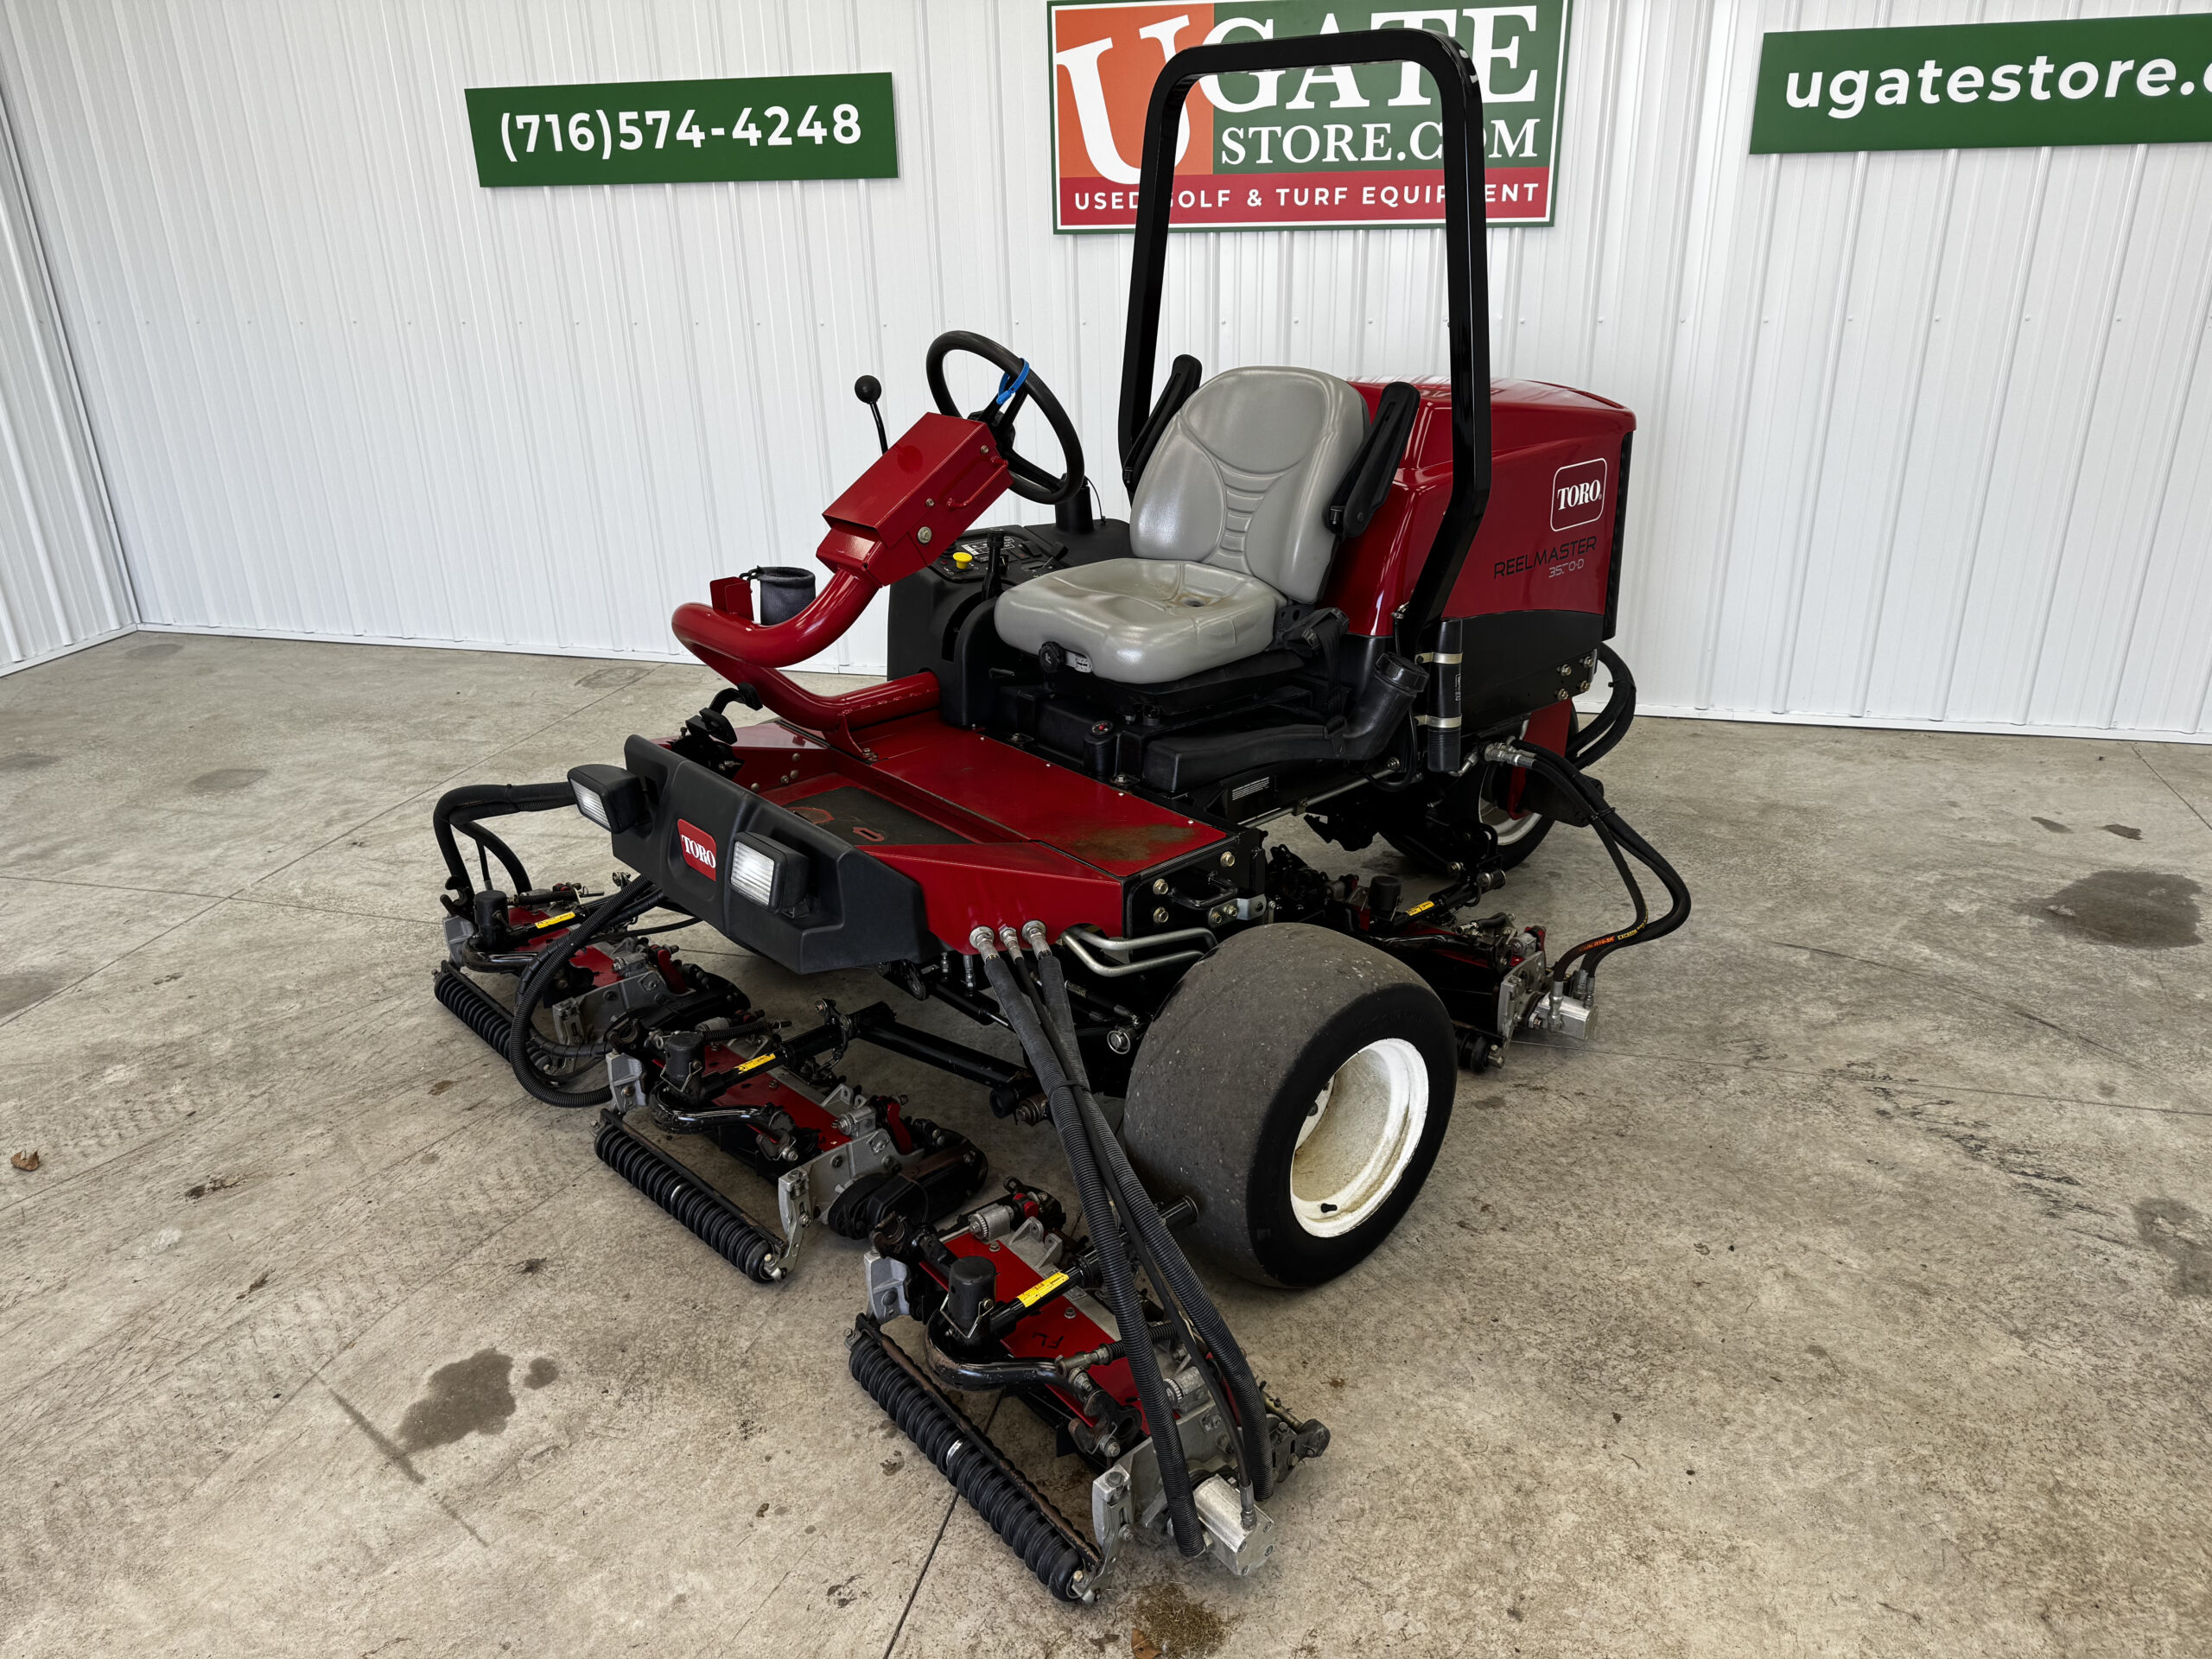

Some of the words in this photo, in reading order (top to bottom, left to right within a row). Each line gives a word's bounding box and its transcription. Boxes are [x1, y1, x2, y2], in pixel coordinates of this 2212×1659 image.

[1785, 55, 2212, 119] ugatestore.
[500, 103, 861, 162] (716)574-4248
[1222, 118, 1541, 165] STORE.CM
[1169, 189, 1230, 209] OLF
[1247, 188, 1262, 207] &
[1275, 187, 1348, 207] TURF
[1362, 182, 1539, 208] EQUIPENT
[1557, 480, 1601, 510] TORO
[1494, 536, 1598, 579] REELMASTER
[681, 834, 716, 868] TORO
